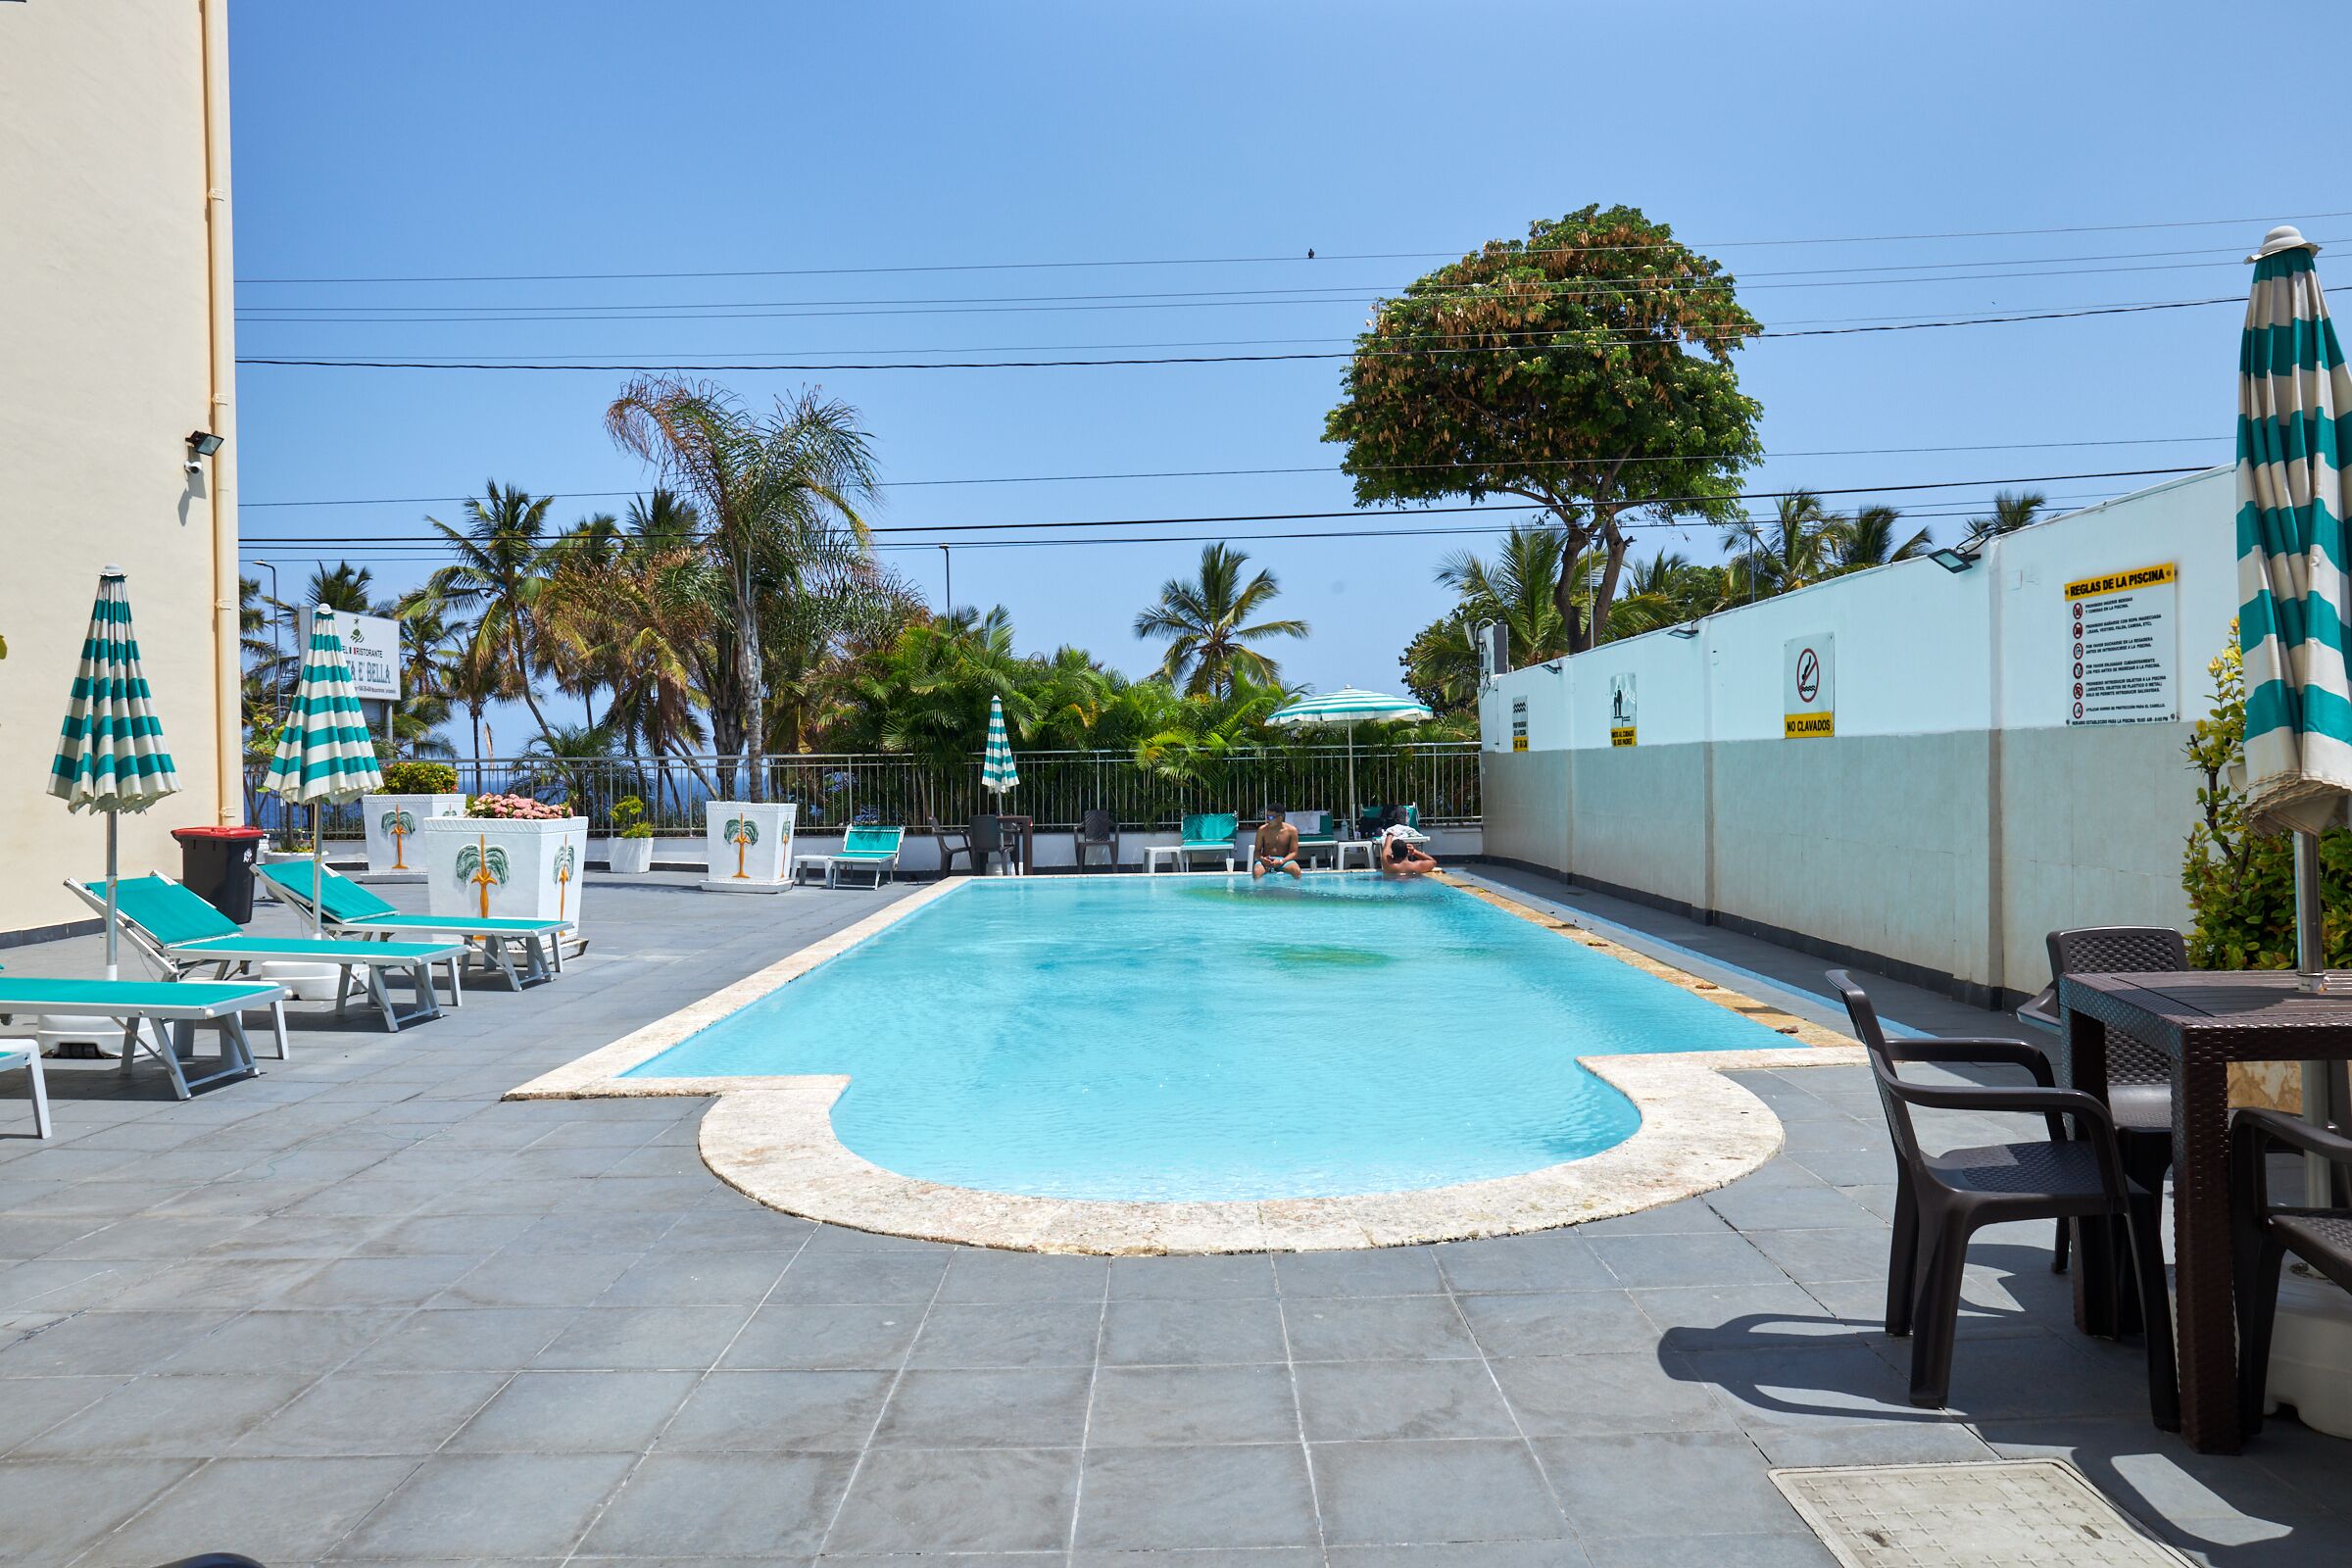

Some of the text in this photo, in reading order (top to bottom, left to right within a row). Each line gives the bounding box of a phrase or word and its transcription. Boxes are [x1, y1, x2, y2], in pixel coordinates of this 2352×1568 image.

[2071, 568, 2165, 596] REGLAS DE LA PISCINA
[357, 647, 383, 658] RISTORANTE
[345, 660, 356, 681] TA
[368, 662, 391, 684] BELLA
[1787, 719, 1831, 732] NO CLAVADOS
